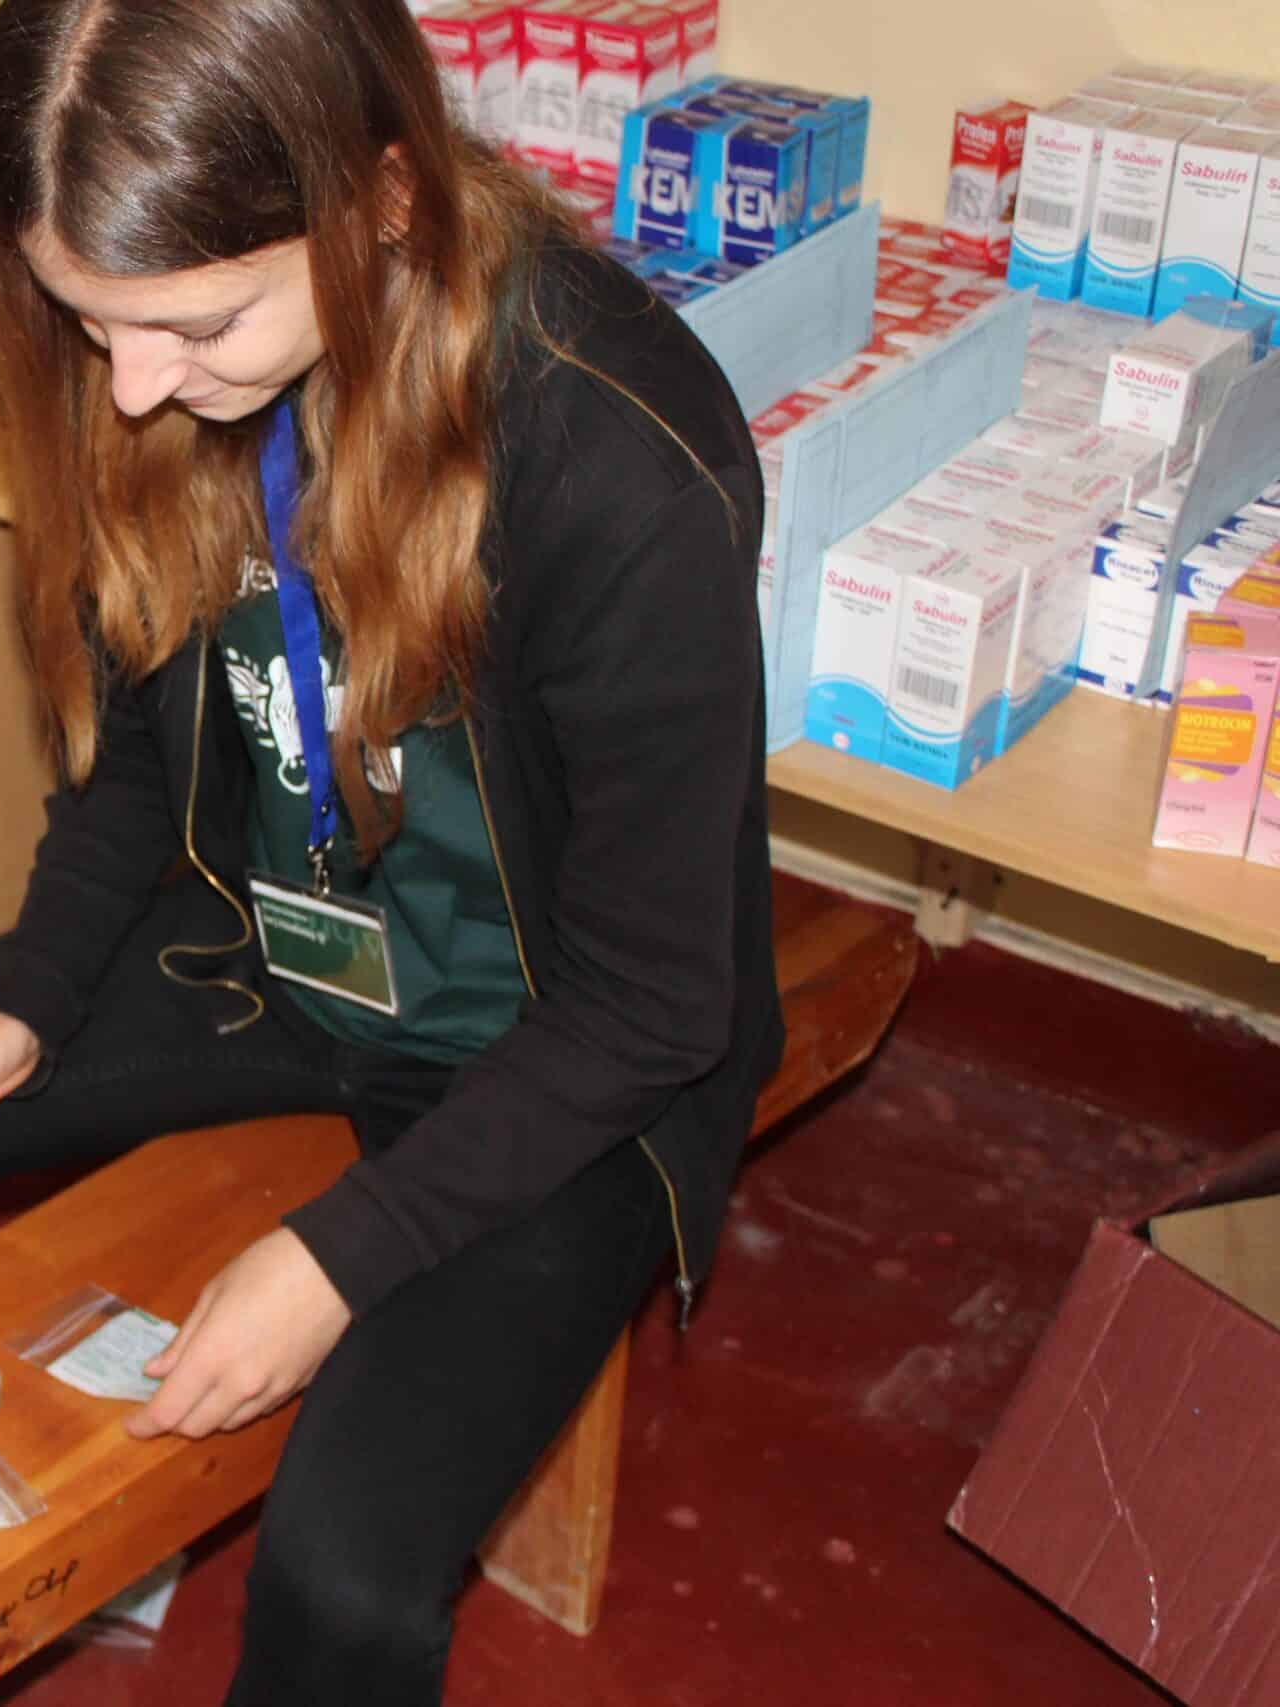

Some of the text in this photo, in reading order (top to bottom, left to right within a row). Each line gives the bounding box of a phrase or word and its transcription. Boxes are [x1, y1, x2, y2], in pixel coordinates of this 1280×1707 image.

[1111, 147, 1163, 168] Sabulin
[1180, 160, 1249, 185] Sabulin
[1112, 360, 1181, 391] Sabulin
[824, 568, 893, 604] Sabulin
[912, 599, 968, 627] Sabulin
